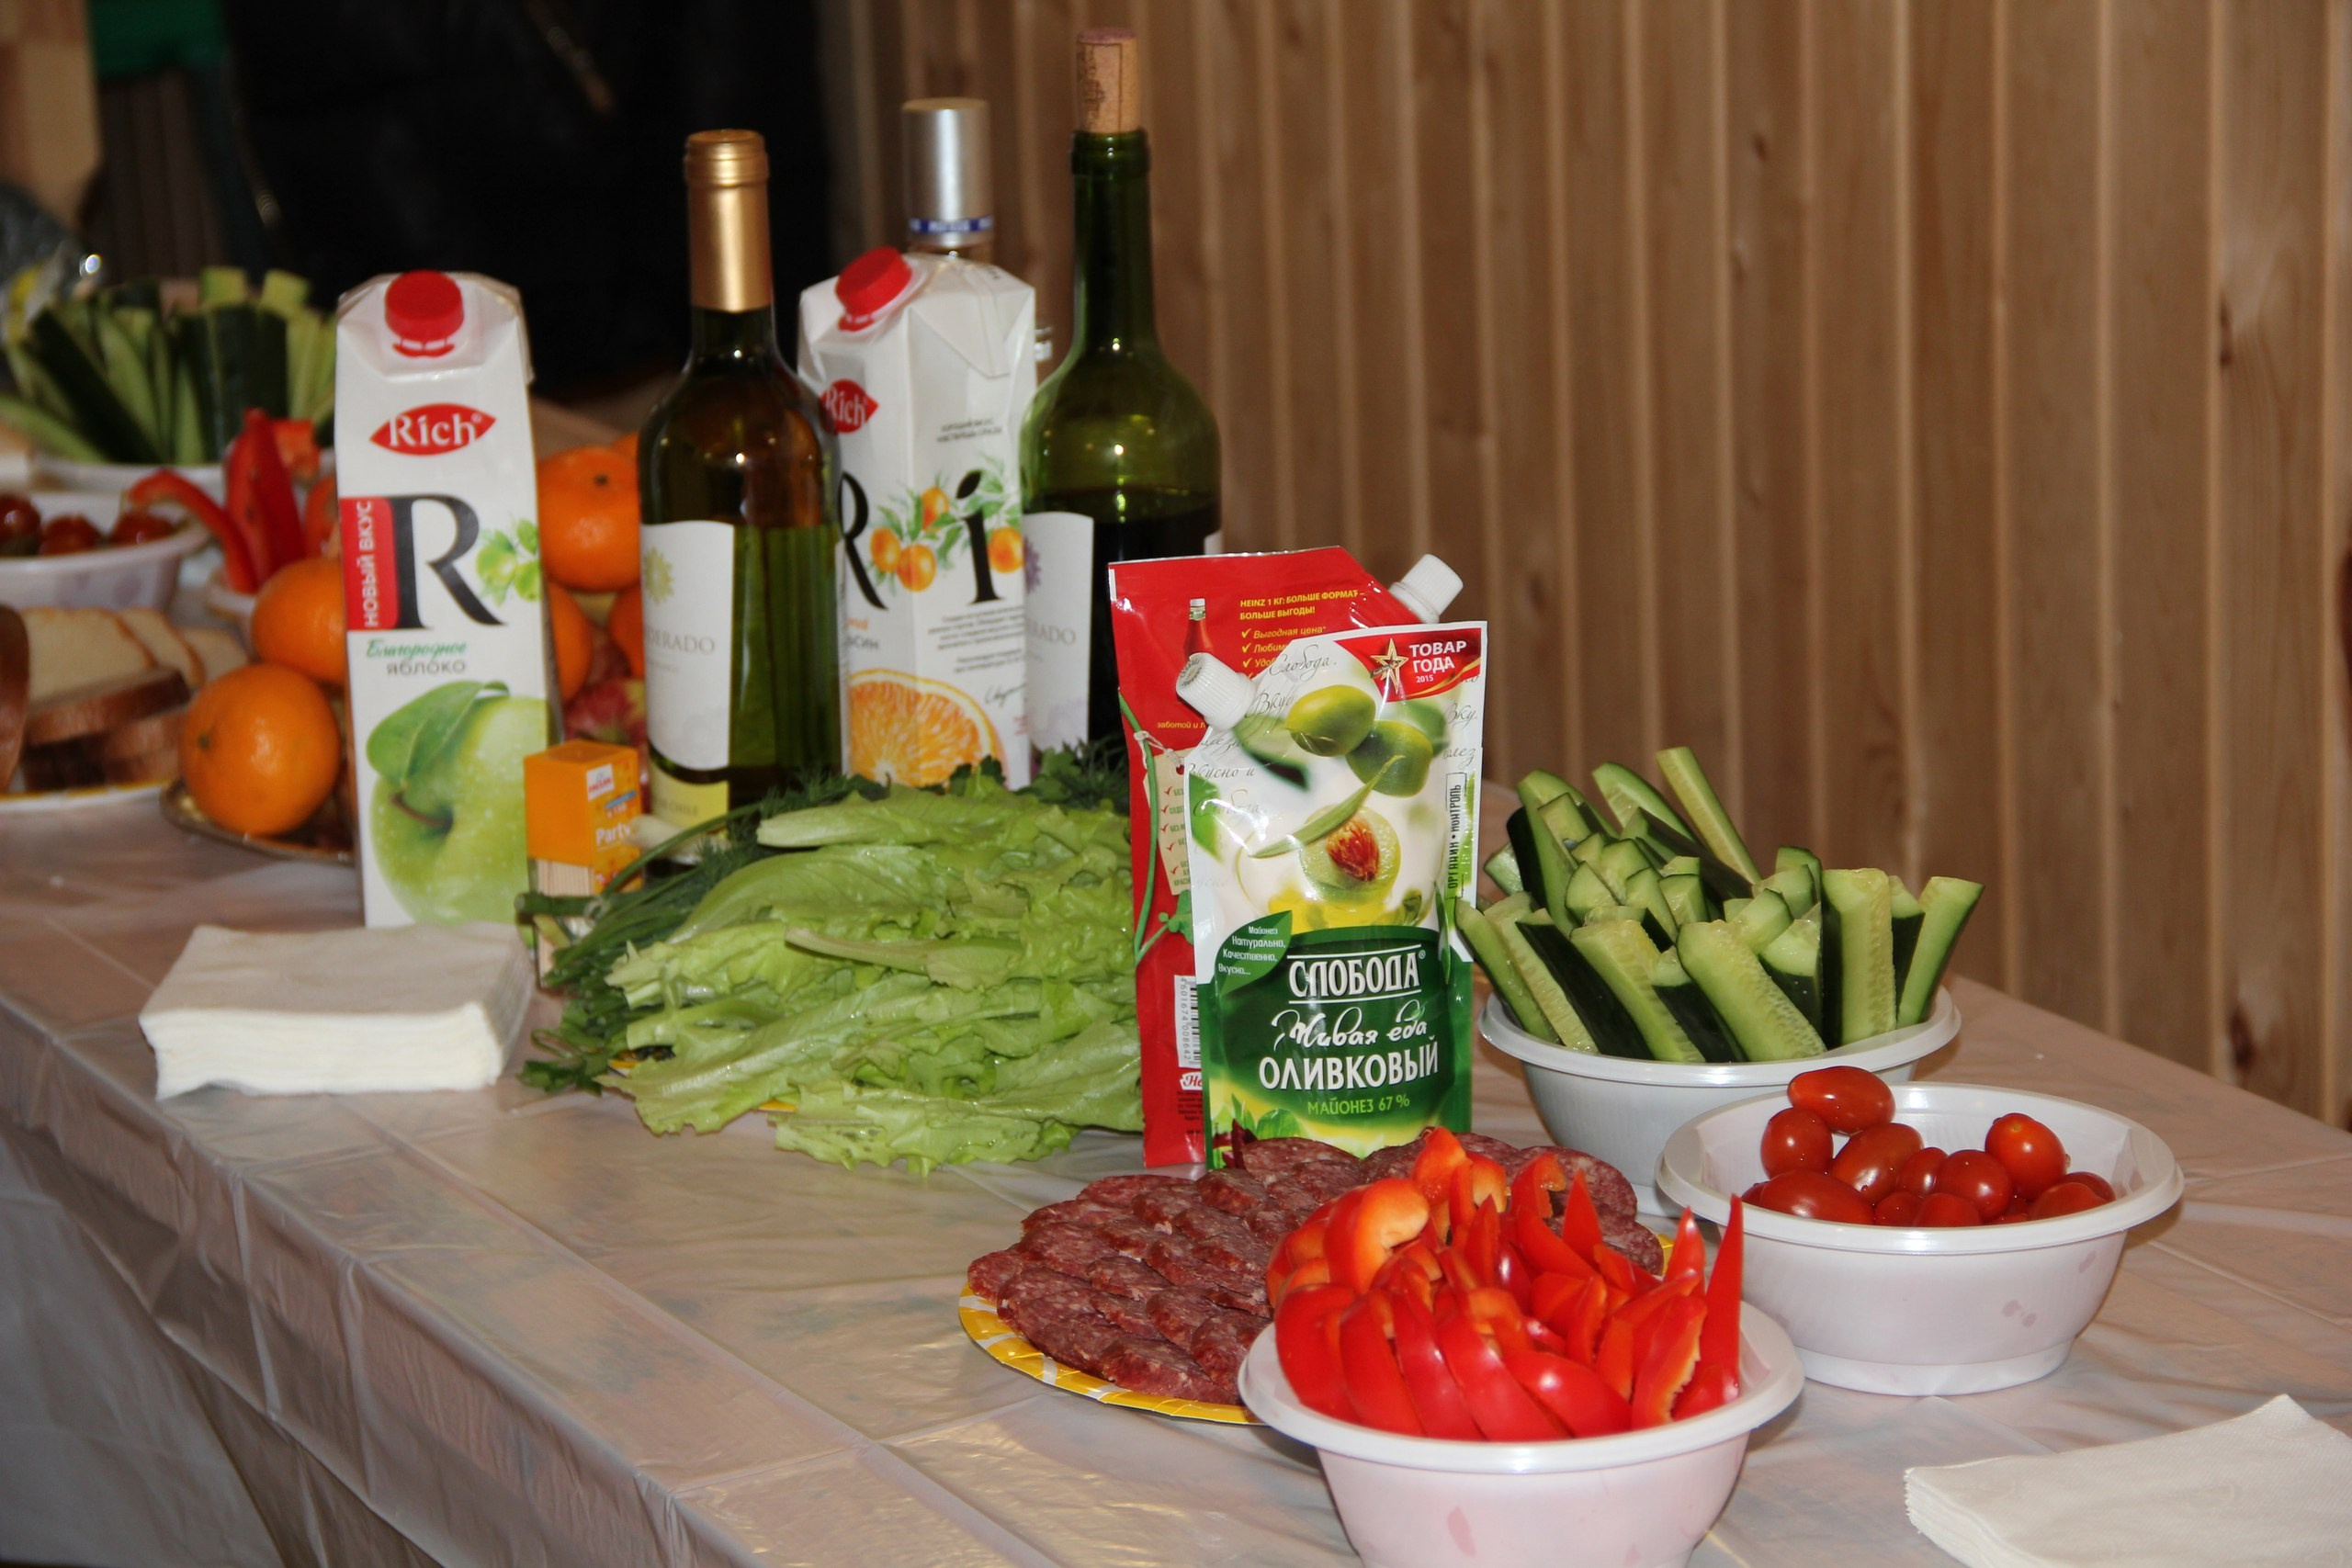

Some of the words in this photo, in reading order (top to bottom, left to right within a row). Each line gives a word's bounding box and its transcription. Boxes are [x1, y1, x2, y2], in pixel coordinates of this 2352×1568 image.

[826, 387, 866, 425] Rich
[389, 412, 477, 447] Rich
[356, 501, 375, 550] ВКУС
[388, 493, 508, 631] R
[356, 553, 379, 627] НОВЫЙ
[1240, 599, 1265, 608] HEINZ
[1286, 592, 1320, 604] БОЛЬШЕ
[1322, 589, 1359, 600] ФОРМАТ
[1239, 609, 1276, 620] БОЛЬШЕ
[1277, 605, 1316, 618] ВЫГОДЫ!
[1253, 628, 1298, 639] Выгодная
[1408, 640, 1467, 658] ТОВАР
[386, 660, 467, 676] яблоко
[1413, 657, 1455, 674] ГОДА
[1416, 674, 1434, 683] 2015
[1157, 721, 1192, 729] заботой
[1248, 925, 1279, 935] Майонез
[1231, 935, 1286, 949] Натурально,
[1222, 948, 1278, 962] Качественно,
[1271, 1006, 1379, 1052] Живая
[1386, 998, 1428, 1042] еда
[1258, 1034, 1439, 1091] ОЛИВКОВЫЙ
[1307, 1097, 1374, 1115] МАЙОНЕЗ
[1378, 1095, 1393, 1111] 67
